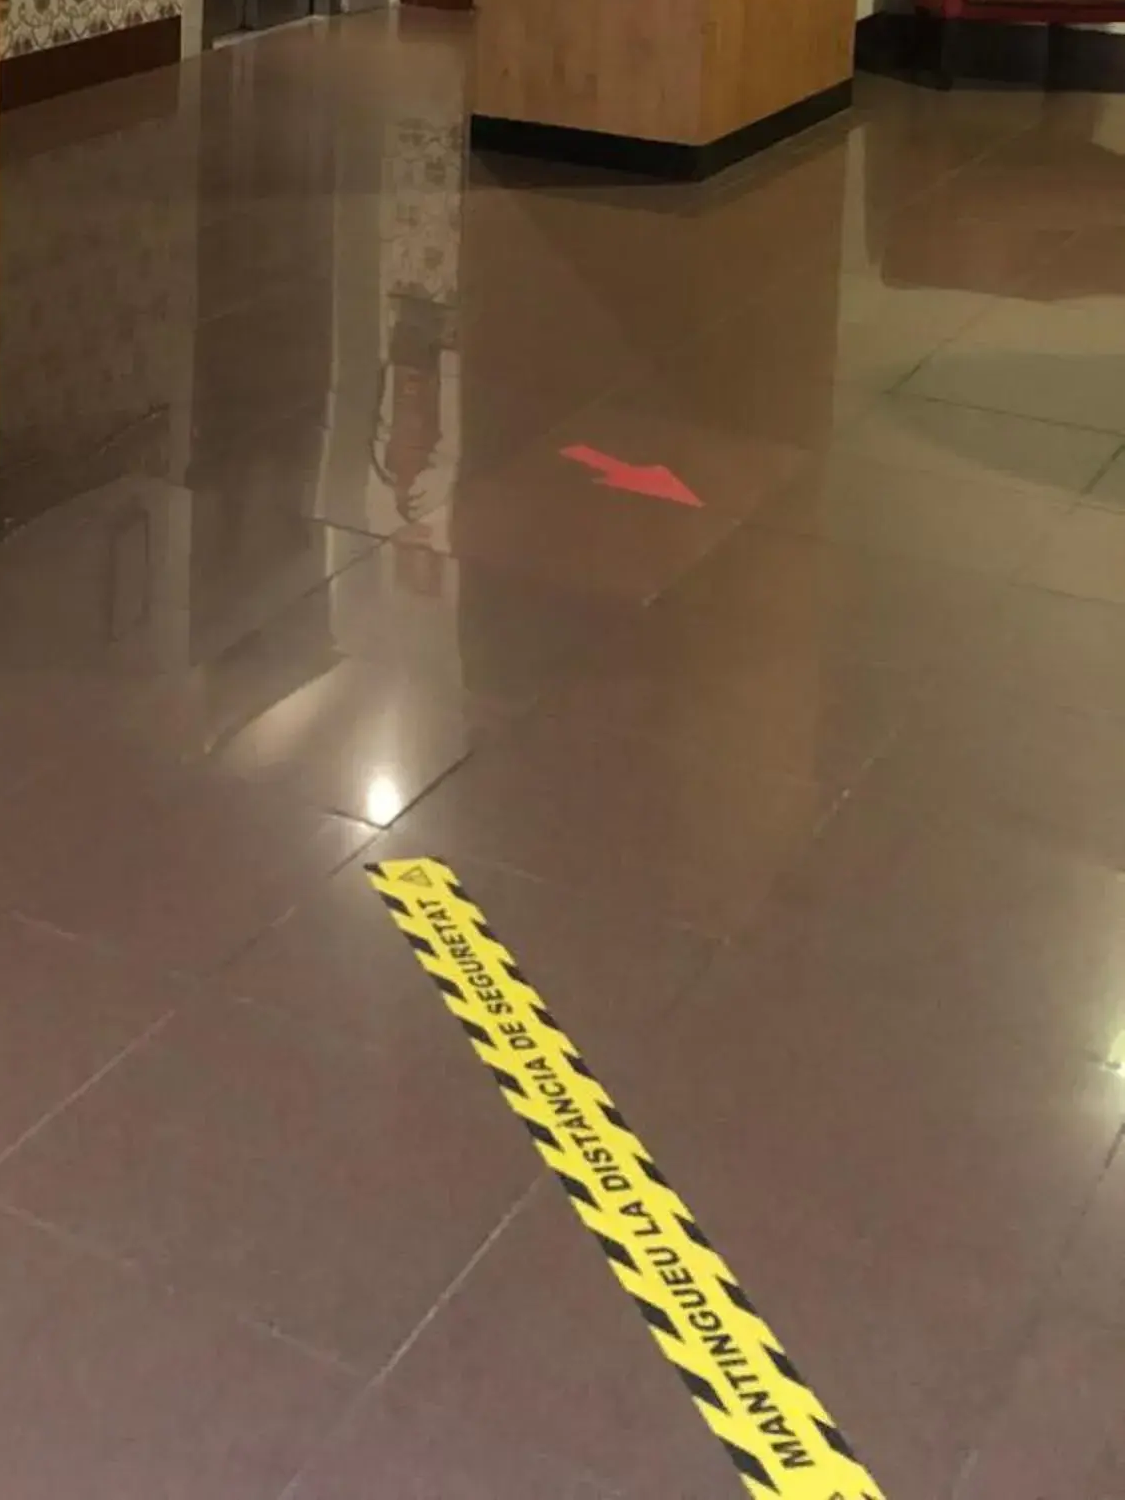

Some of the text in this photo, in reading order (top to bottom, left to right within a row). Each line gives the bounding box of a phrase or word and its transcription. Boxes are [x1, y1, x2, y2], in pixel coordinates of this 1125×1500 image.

[418, 898, 513, 1015] SEGURETAT
[500, 1019, 537, 1051] DE
[619, 1199, 661, 1237] LA
[645, 1246, 815, 1469] MANTINGUEU
